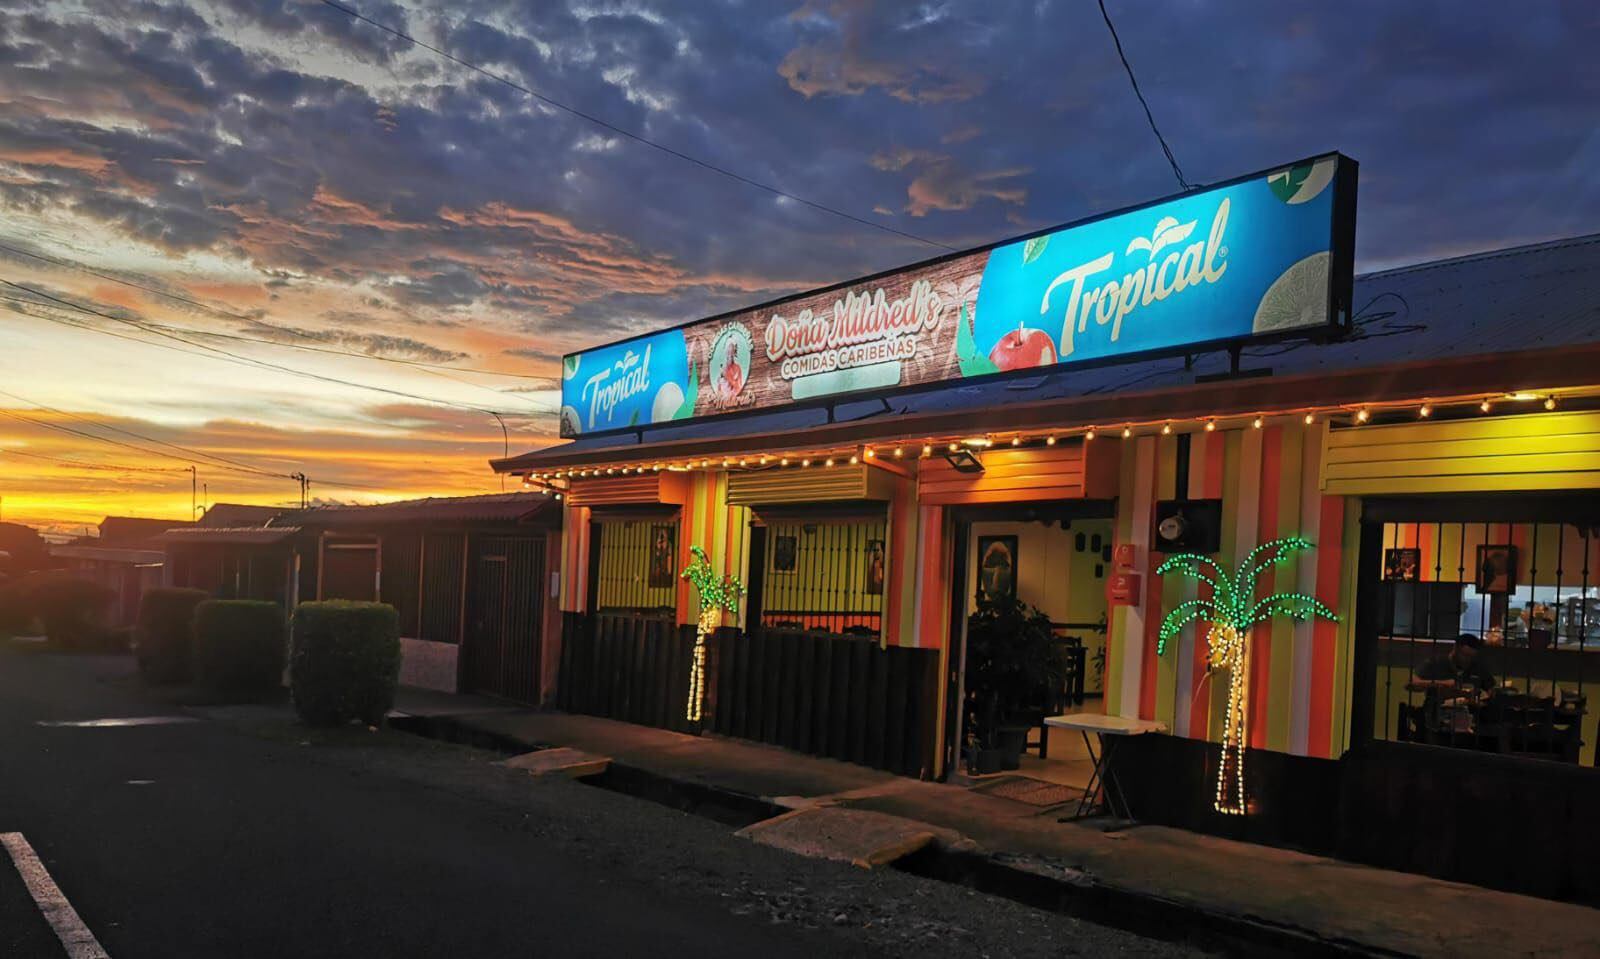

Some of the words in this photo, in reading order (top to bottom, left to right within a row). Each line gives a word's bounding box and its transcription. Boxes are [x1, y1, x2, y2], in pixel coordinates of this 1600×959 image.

[1041, 197, 1231, 357] Tropical
[767, 310, 827, 359] Doña
[831, 281, 942, 344] Mildred's
[782, 350, 835, 376] COMIDAS
[839, 337, 914, 366] CARIBEÑAS
[582, 344, 651, 429] Tropical
